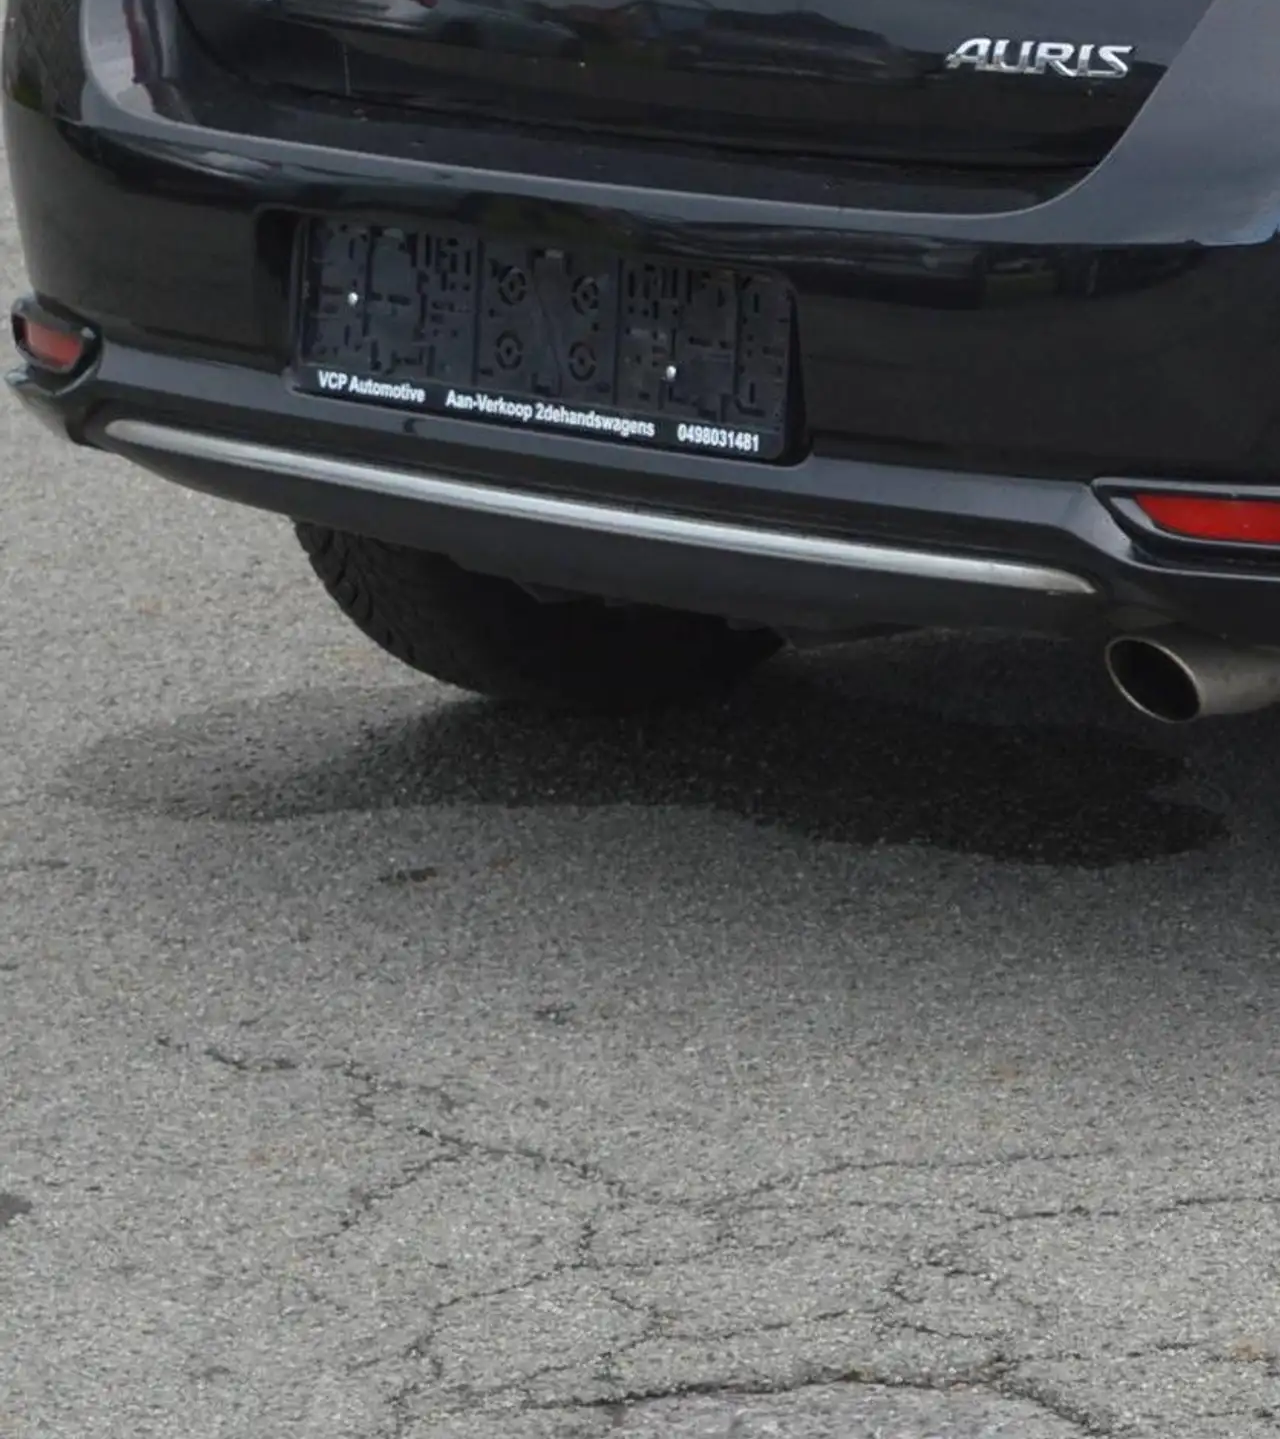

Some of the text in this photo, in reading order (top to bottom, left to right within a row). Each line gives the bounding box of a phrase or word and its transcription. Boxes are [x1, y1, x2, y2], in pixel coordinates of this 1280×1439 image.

[945, 37, 1134, 78] AURIS
[317, 369, 760, 453] VCP Automotive Aan-Verkoop 2dehandswagens 0498031481
